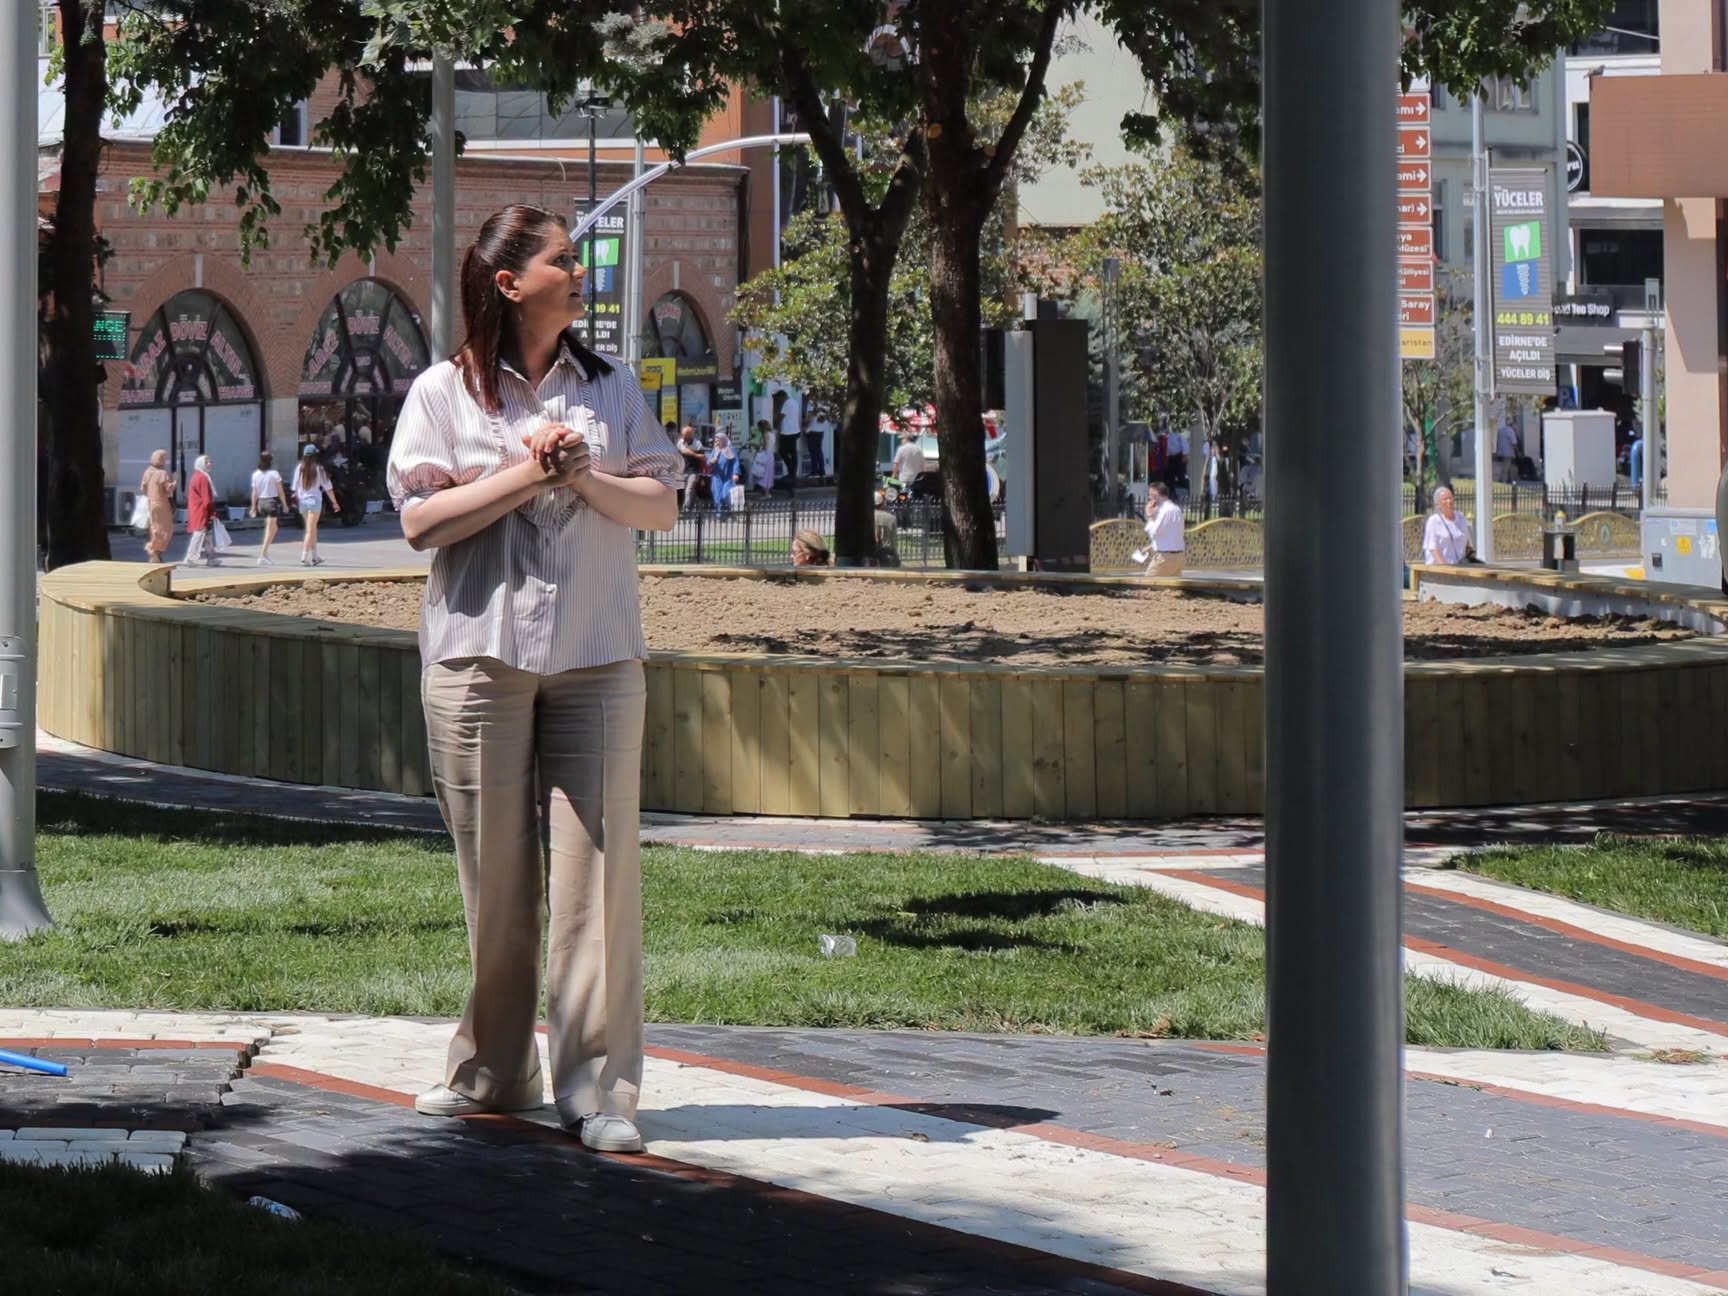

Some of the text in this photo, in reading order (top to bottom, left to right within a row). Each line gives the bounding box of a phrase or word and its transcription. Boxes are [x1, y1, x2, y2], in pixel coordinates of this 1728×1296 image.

[1494, 188, 1543, 207] YÜCELER
[576, 213, 625, 228] YELER
[1401, 299, 1431, 312] Saray
[1587, 303, 1610, 317] Shop
[1497, 312, 1549, 325] 444 89 41
[1499, 333, 1547, 347] EDİRNE'DE
[1509, 350, 1540, 363] AÇILDI
[1501, 366, 1536, 379] YÜCELER
